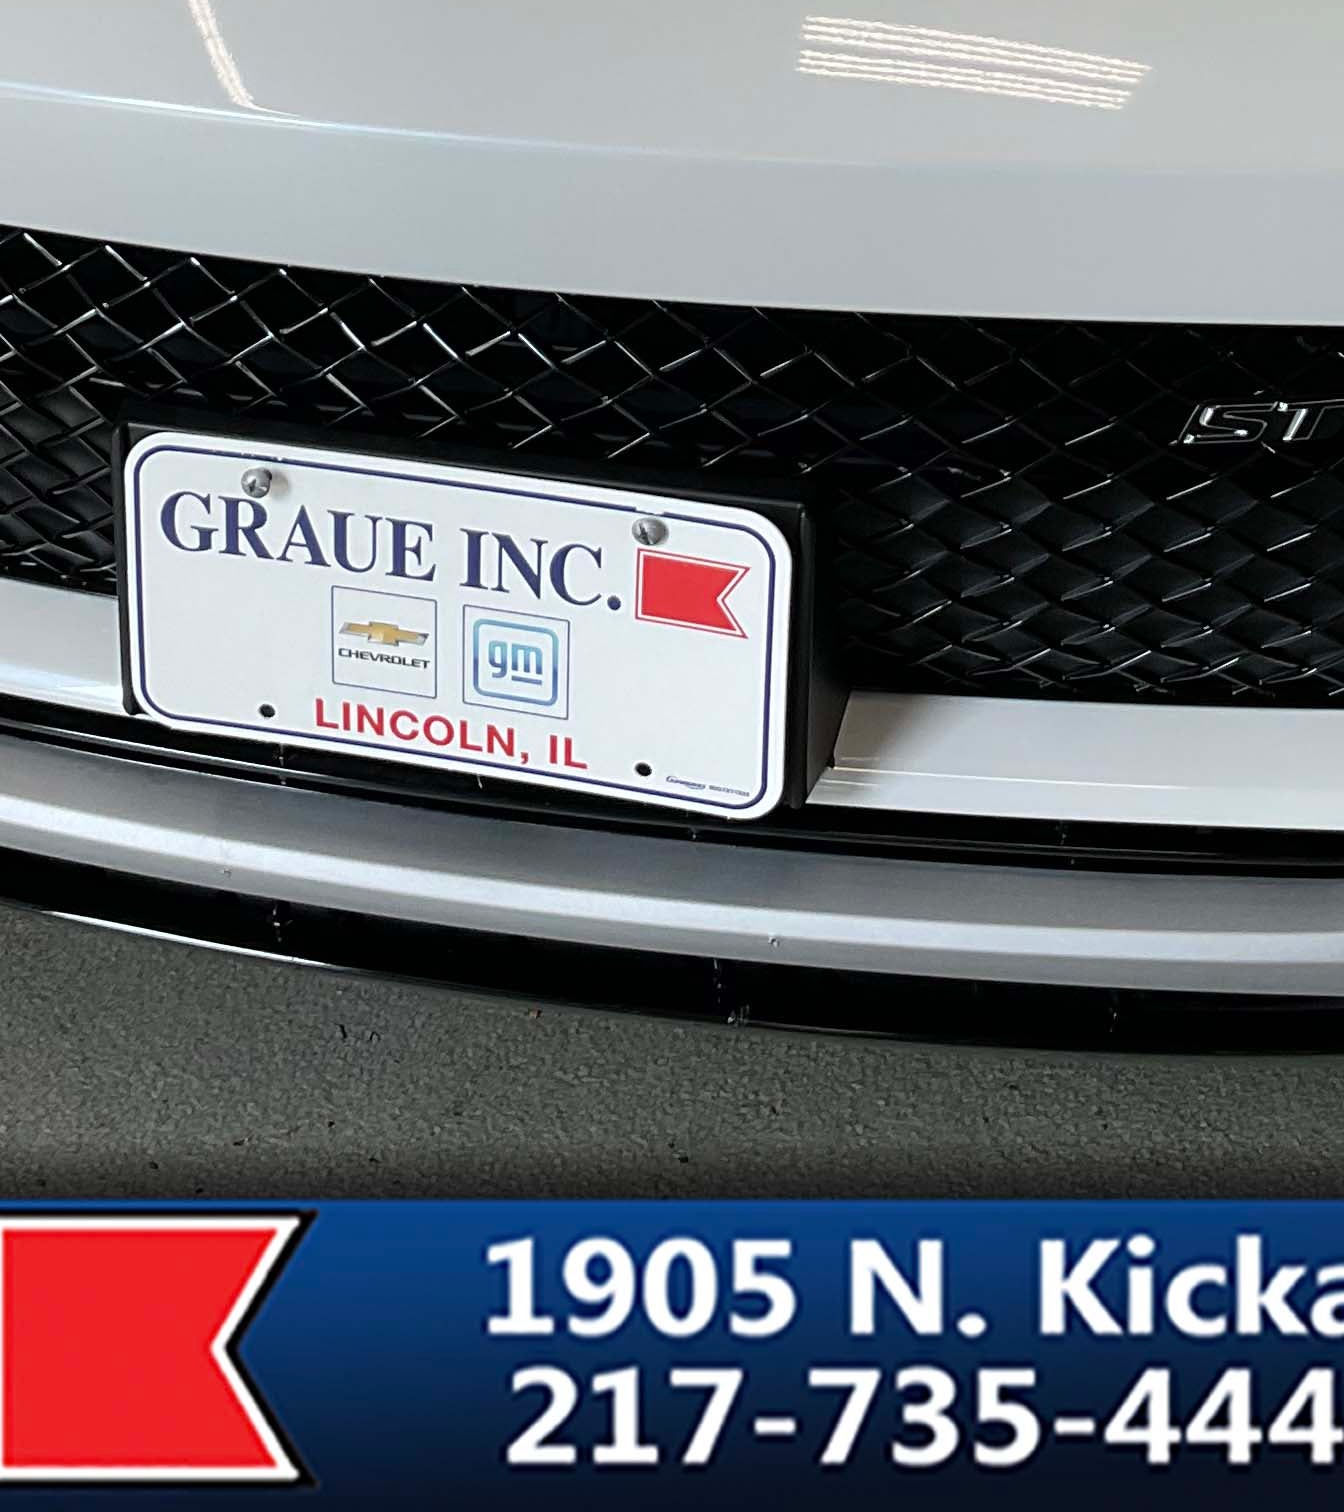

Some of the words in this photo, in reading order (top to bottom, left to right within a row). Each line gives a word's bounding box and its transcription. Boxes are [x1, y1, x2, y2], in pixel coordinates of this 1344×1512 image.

[160, 490, 437, 582] GRAUE
[459, 528, 622, 610] INC.
[338, 646, 431, 670] CHEVROLET
[487, 639, 544, 686] gm
[315, 697, 530, 765] LINCOLN,
[549, 734, 588, 770] IL
